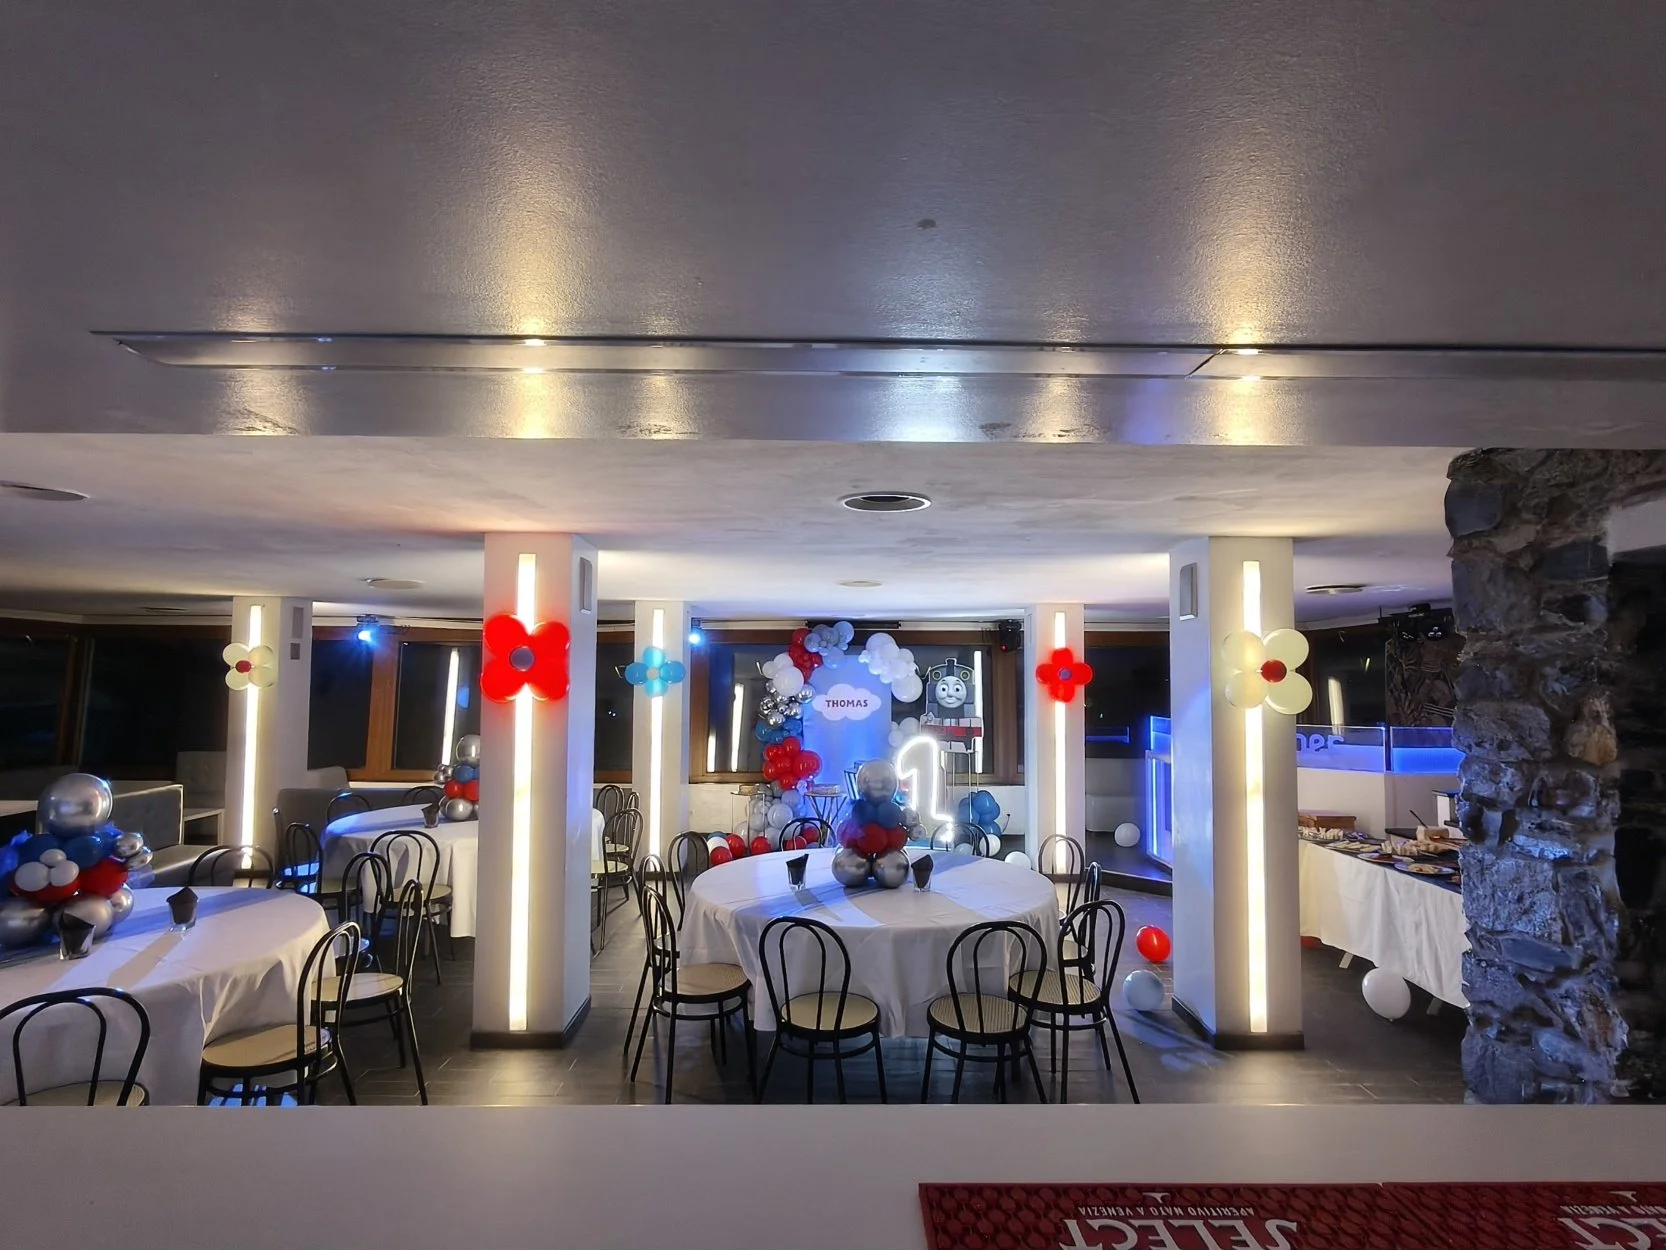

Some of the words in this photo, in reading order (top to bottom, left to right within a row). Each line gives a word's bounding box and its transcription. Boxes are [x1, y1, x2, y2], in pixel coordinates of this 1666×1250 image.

[825, 699, 868, 708] THOMAS
[1079, 1207, 1133, 1216] VENEZIA
[1060, 1218, 1298, 1250] SELECT
